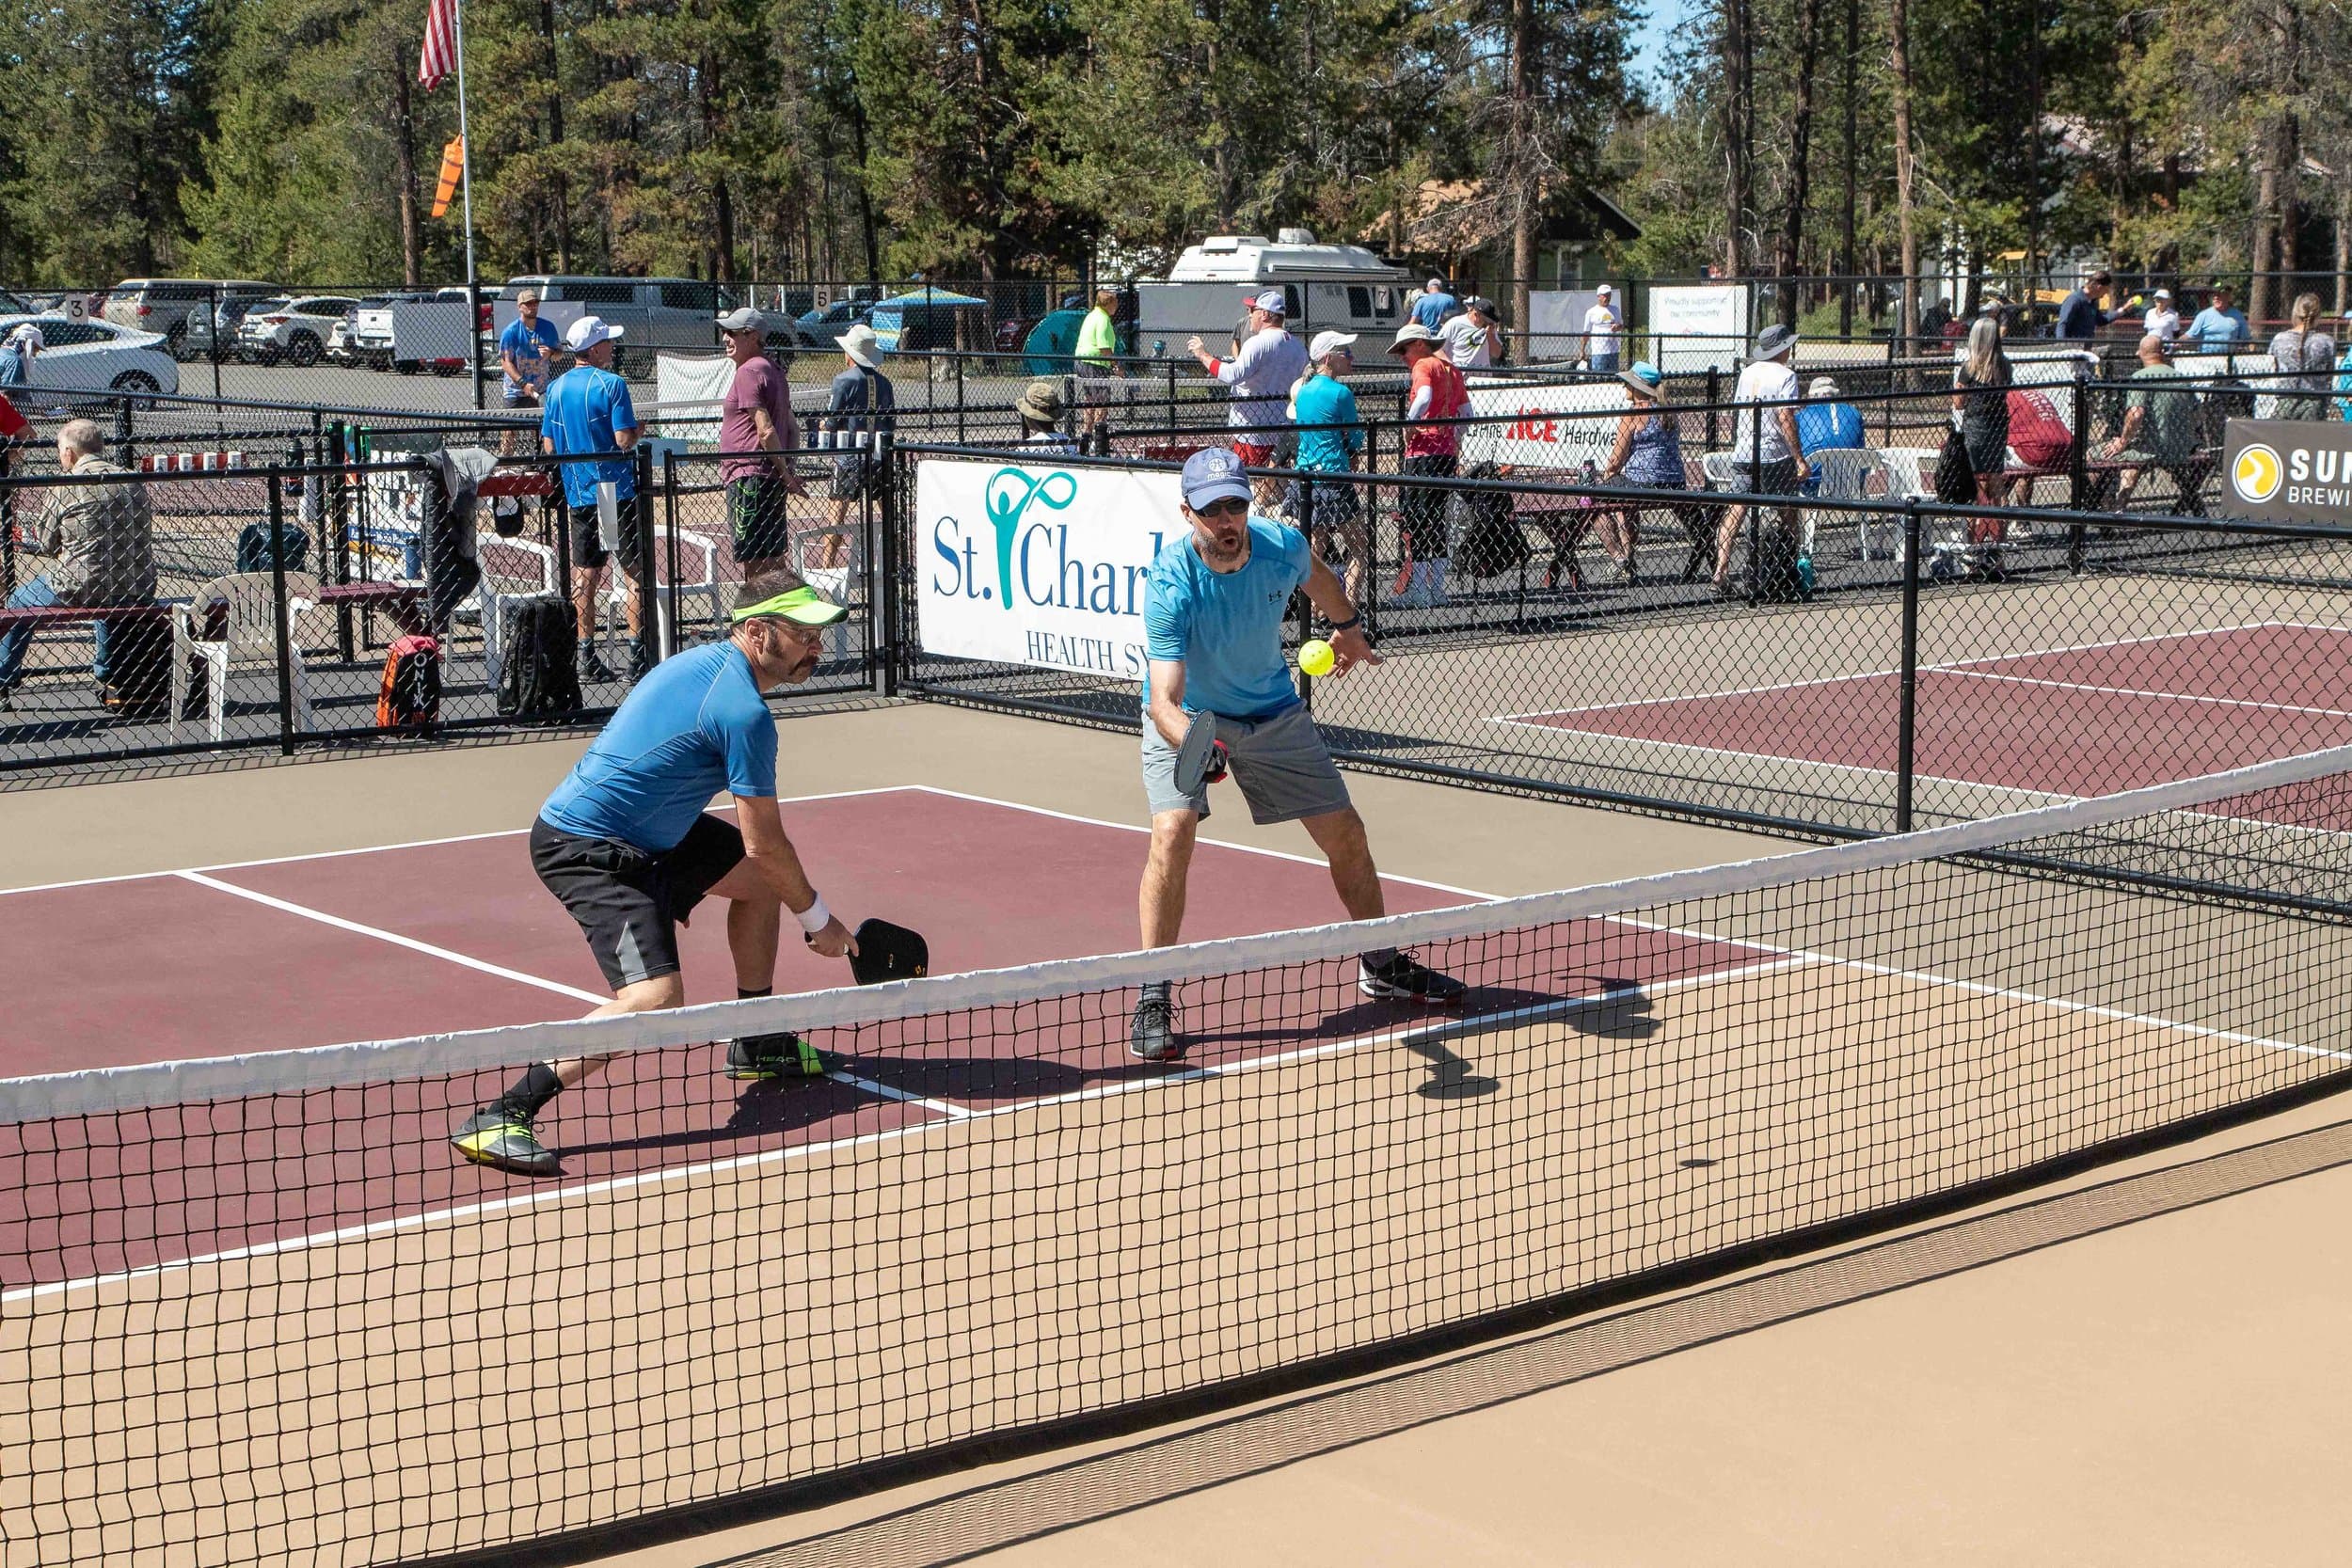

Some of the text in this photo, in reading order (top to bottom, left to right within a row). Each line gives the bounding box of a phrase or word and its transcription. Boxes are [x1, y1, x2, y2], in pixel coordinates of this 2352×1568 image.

[71, 300, 84, 317] 3
[818, 292, 827, 307] 5
[1377, 291, 1387, 303] 7
[1506, 404, 1558, 442] ACE
[934, 515, 1163, 616] St. Char
[1026, 630, 1116, 672] HEALTH
[413, 653, 427, 708] ONIX
